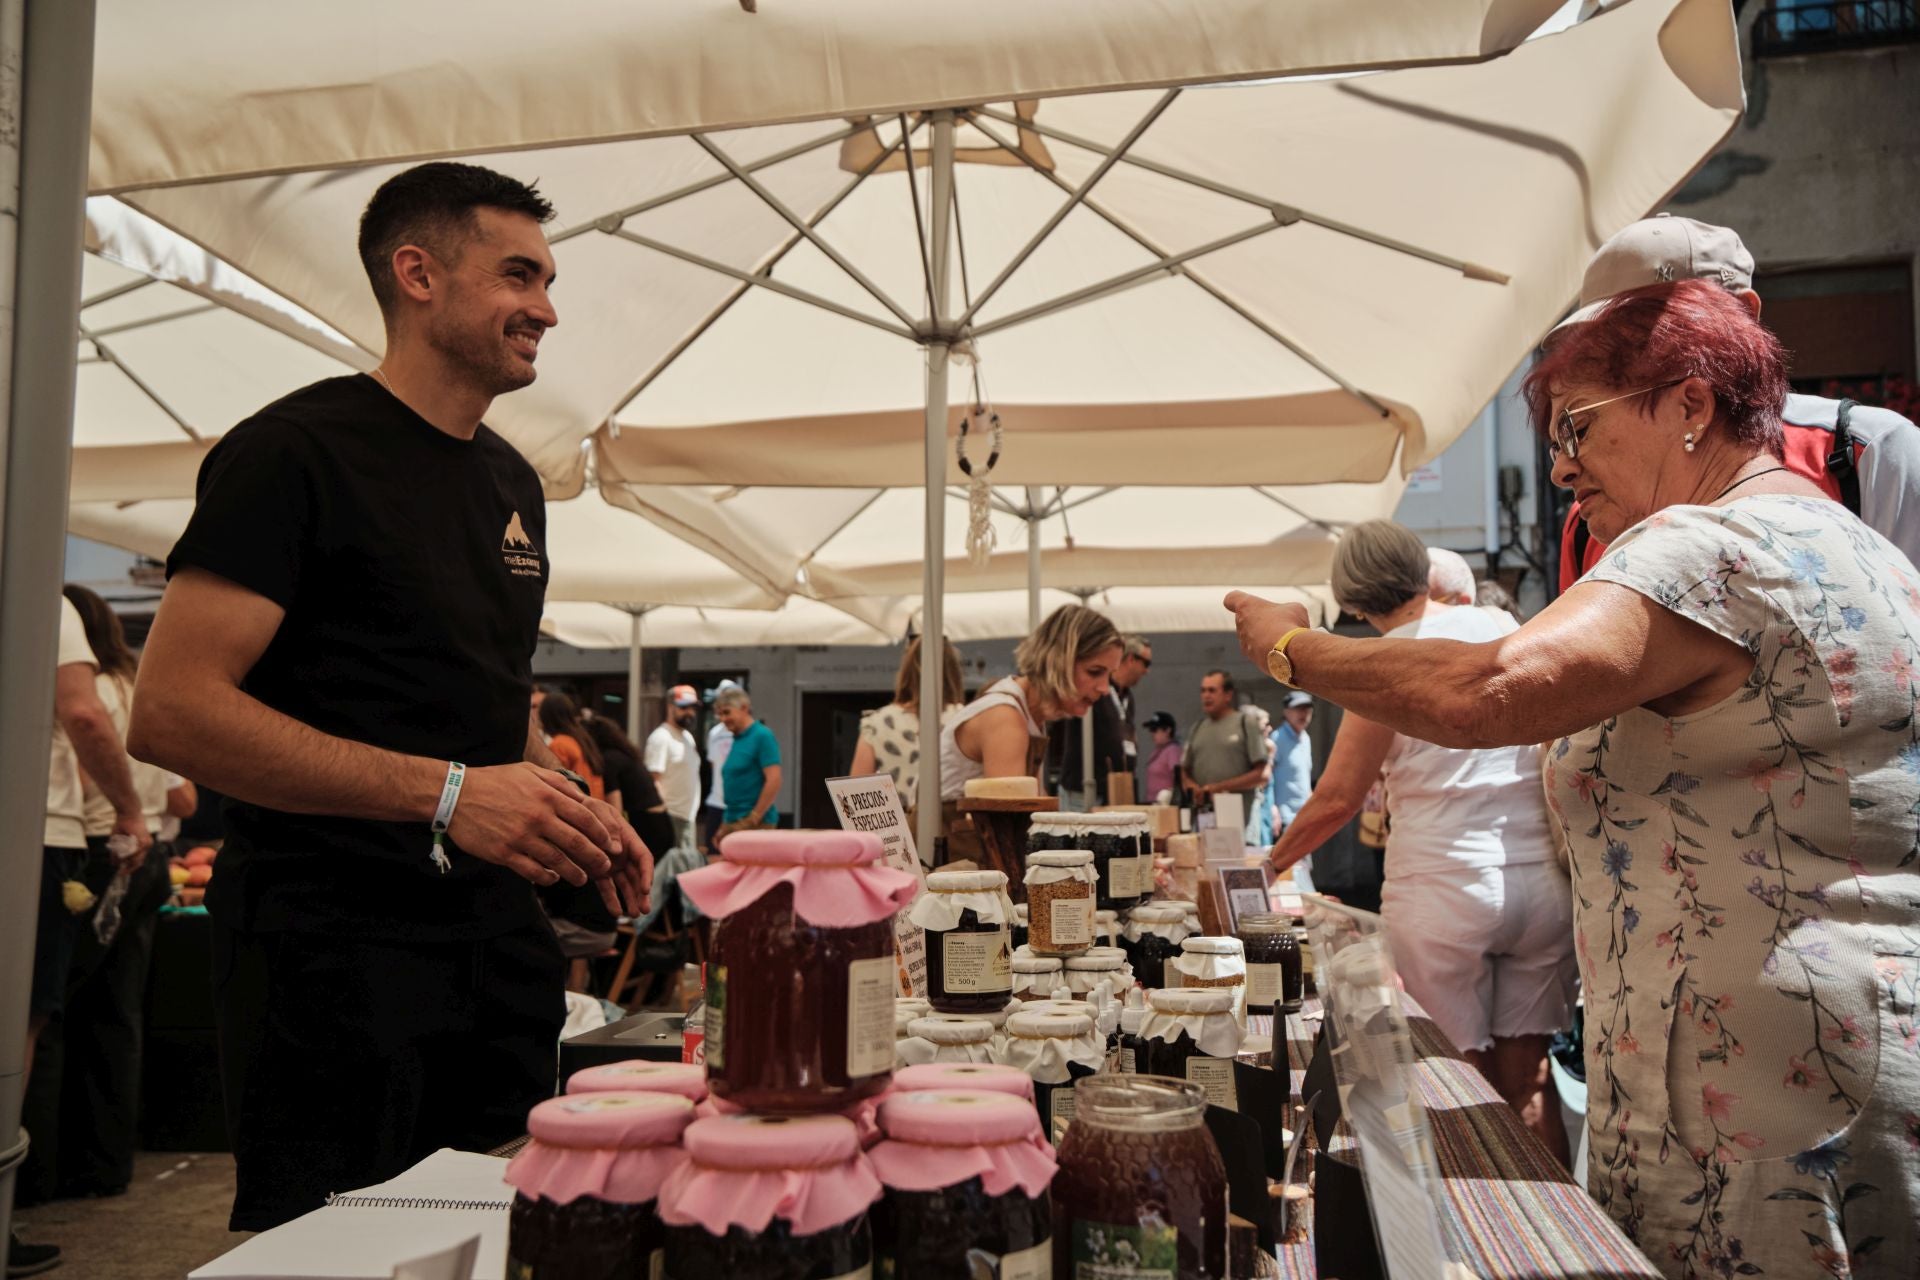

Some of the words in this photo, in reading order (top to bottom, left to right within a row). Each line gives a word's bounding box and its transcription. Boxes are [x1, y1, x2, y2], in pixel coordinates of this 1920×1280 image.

[1655, 263, 1675, 282] NY
[851, 790, 886, 811] PRECIOS
[852, 810, 899, 831] ESPECIALES
